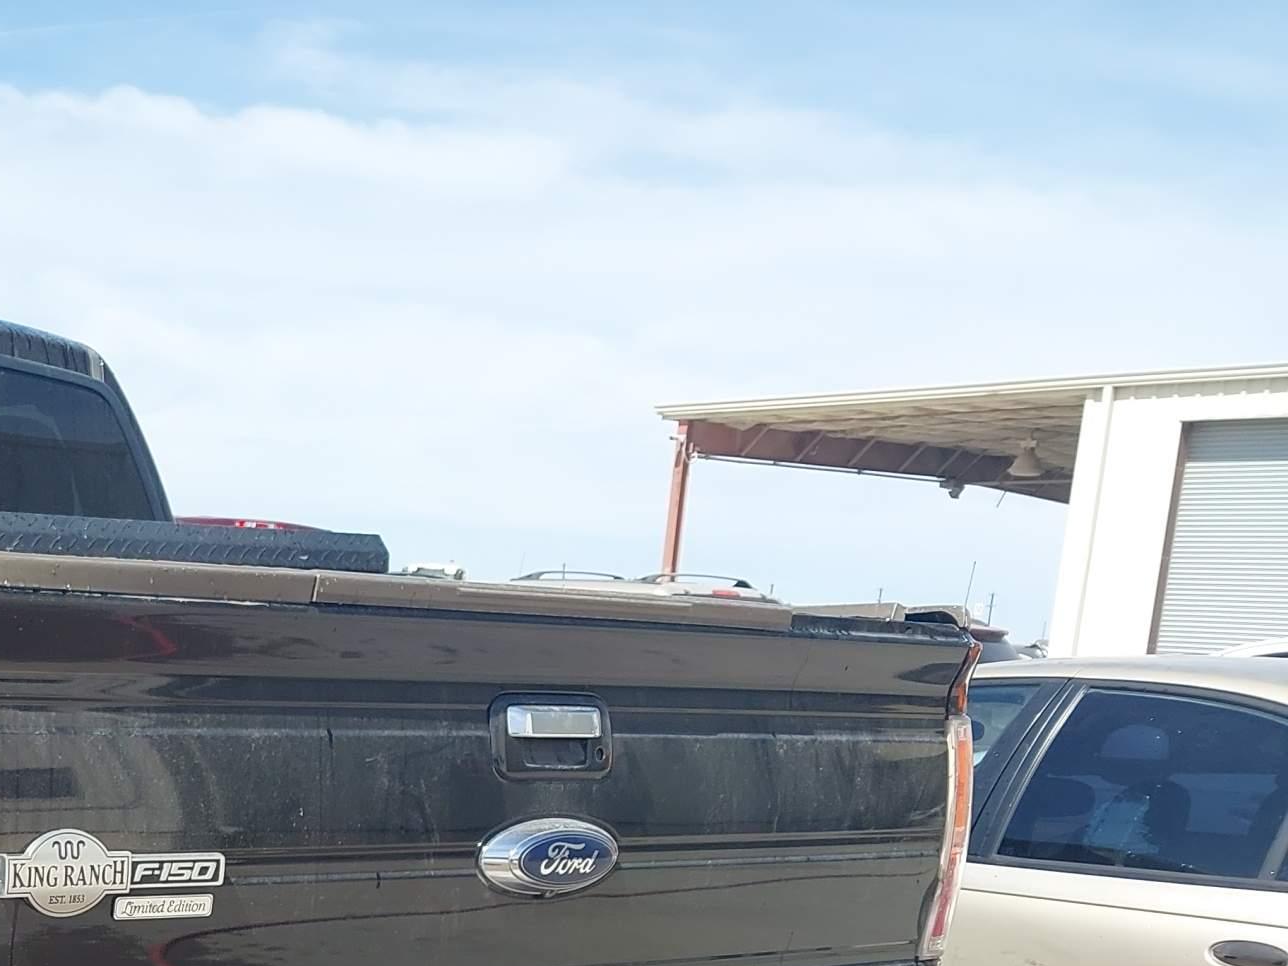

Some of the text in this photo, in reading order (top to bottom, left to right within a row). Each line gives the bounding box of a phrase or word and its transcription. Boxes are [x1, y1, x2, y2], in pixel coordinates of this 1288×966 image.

[540, 842, 600, 876] Ford
[12, 859, 126, 889] KING RANCH
[133, 861, 217, 883] F-150
[48, 894, 85, 905] EST. 1853
[121, 901, 206, 917] Limited Edition
